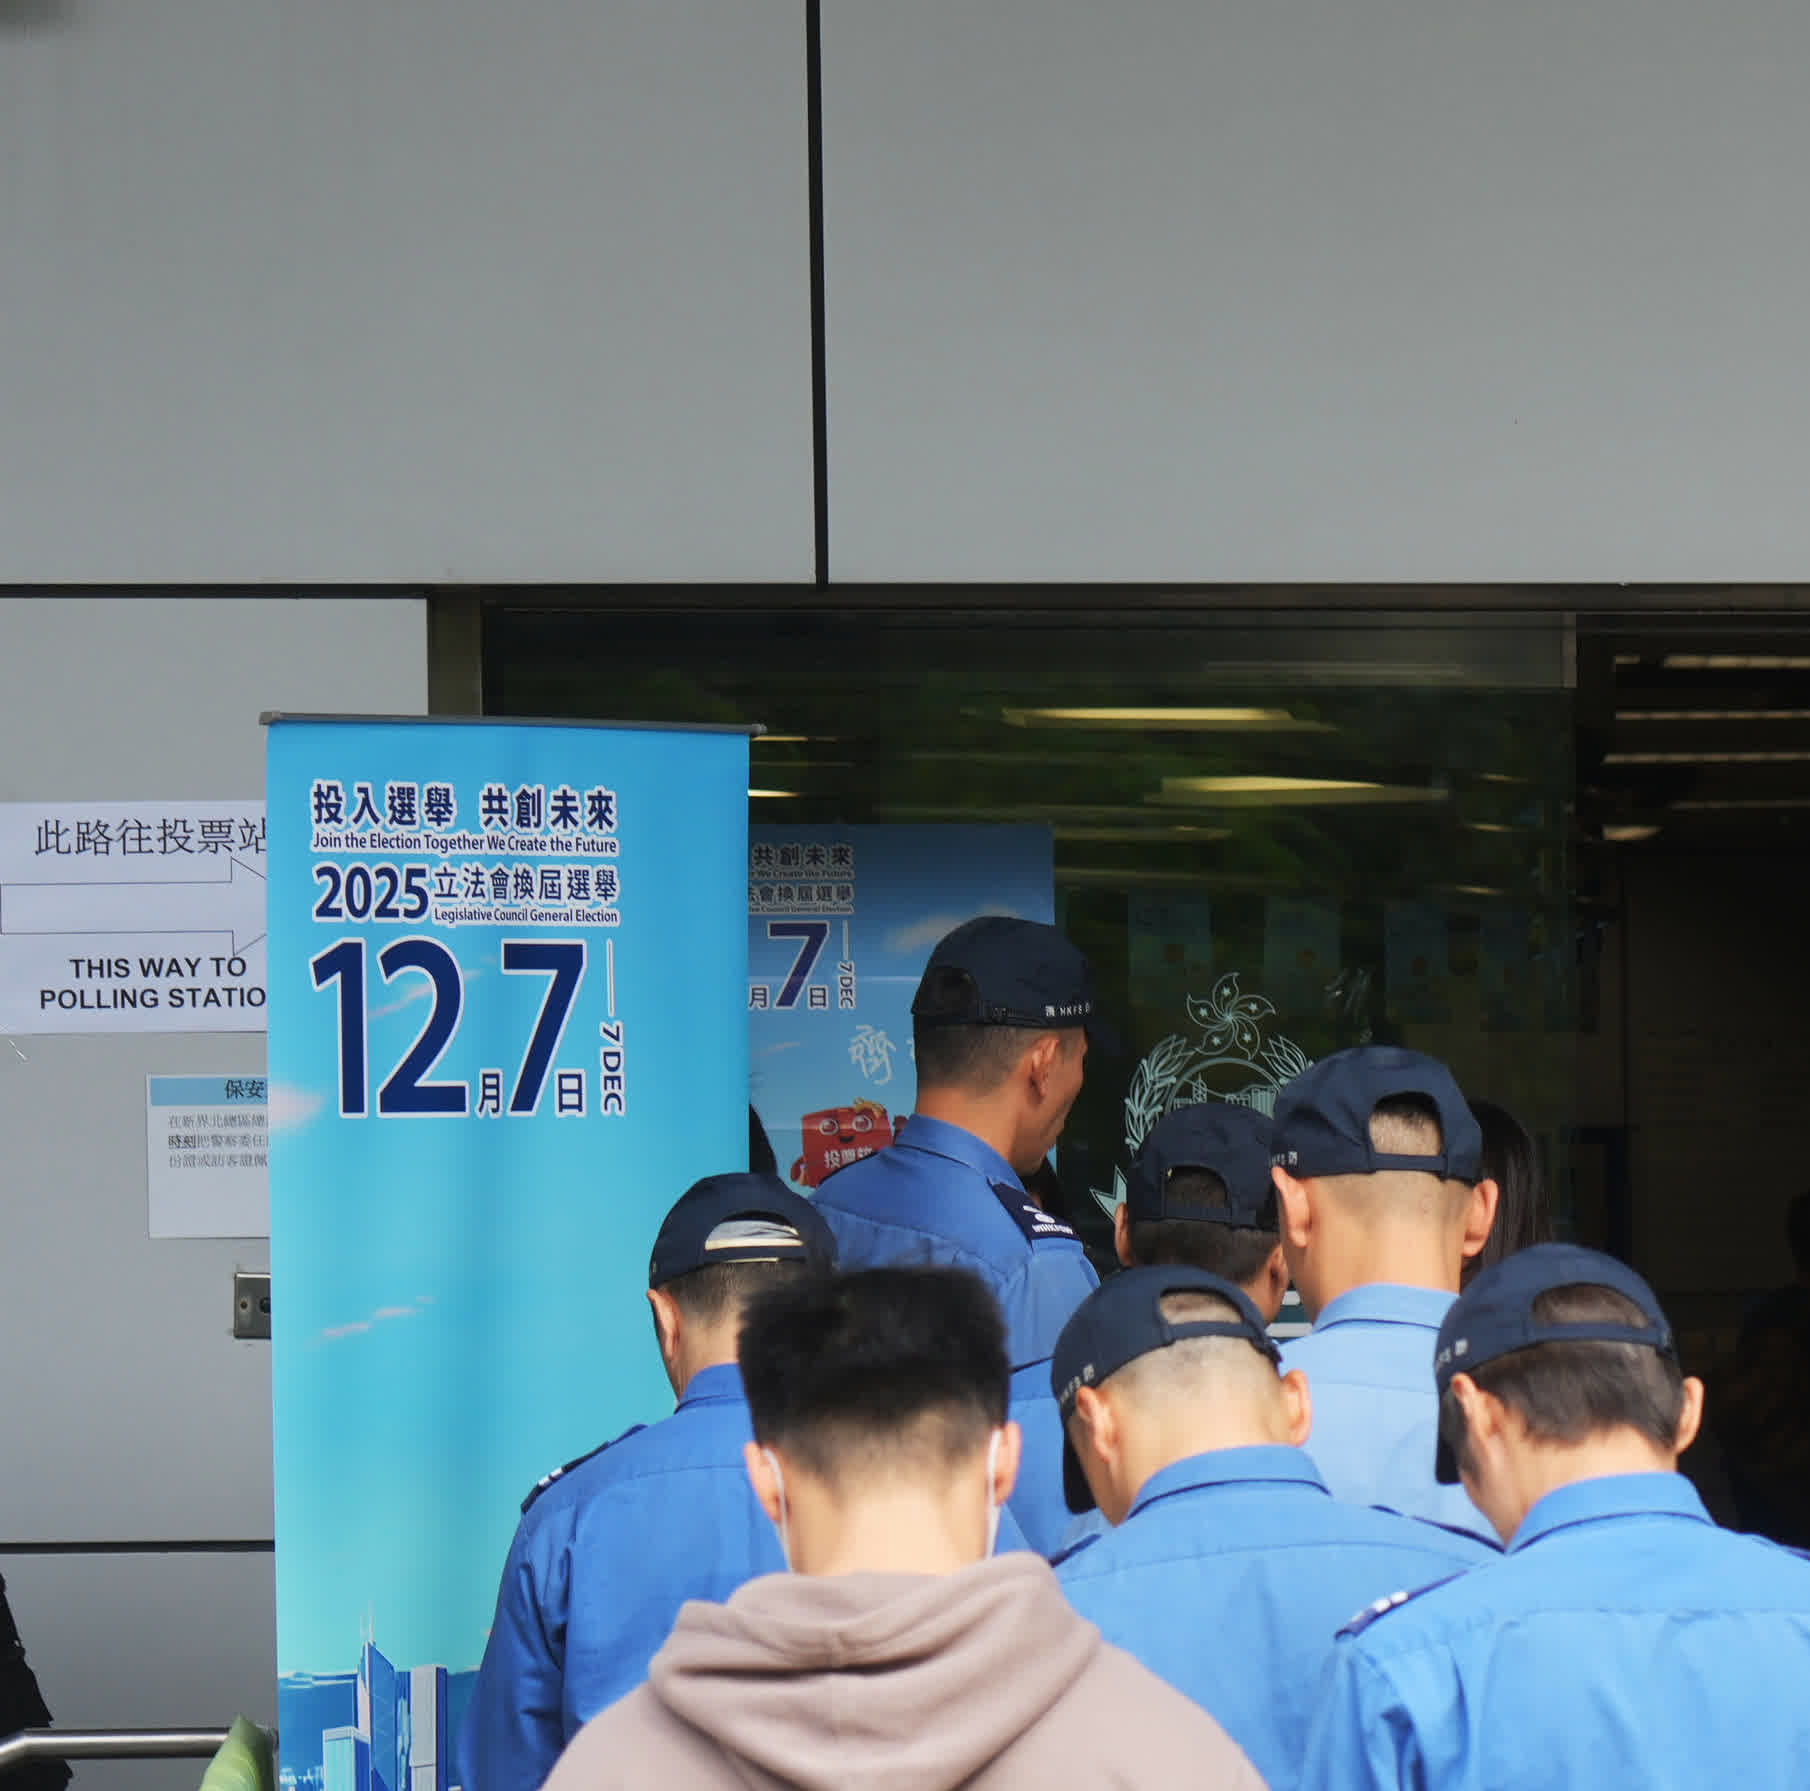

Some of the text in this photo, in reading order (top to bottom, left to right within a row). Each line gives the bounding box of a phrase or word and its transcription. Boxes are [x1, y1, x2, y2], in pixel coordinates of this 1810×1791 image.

[313, 783, 615, 830] 投入選舉 共創未來
[35, 817, 266, 856] 此路往投票站
[314, 832, 617, 853] Join the Election Together We Create the Future
[315, 865, 617, 919] 2025 立法會換屆選舉
[434, 907, 618, 924] Legislative Council General Election
[69, 957, 247, 979] THIS WAY TO
[40, 988, 159, 1010] POLLING
